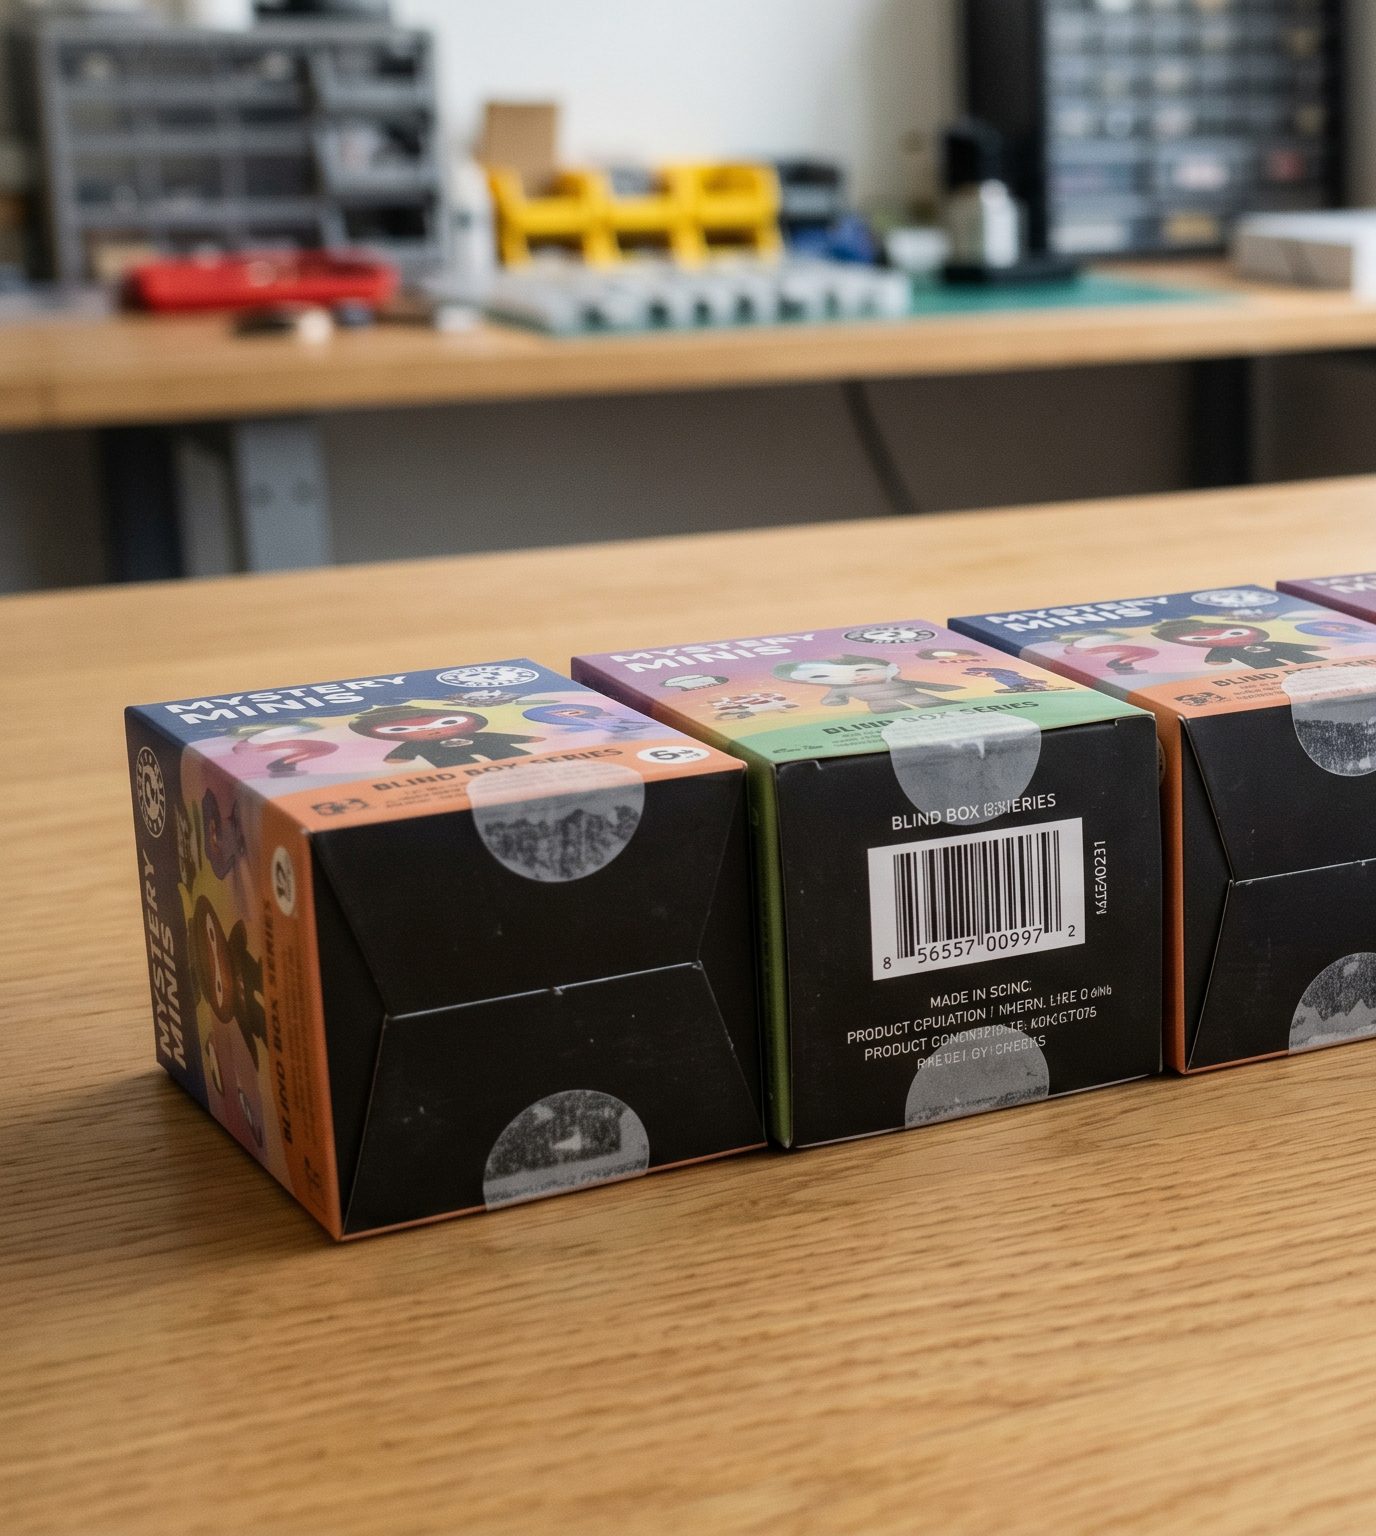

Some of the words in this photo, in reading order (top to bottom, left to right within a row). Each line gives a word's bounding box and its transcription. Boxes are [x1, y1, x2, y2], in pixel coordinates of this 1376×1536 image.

[1003, 606, 1154, 633] MINIS
[609, 633, 819, 663] MYSTERY
[623, 645, 794, 673] MINIS
[1211, 673, 1280, 687] BLIND
[164, 675, 407, 715] MYSTERY
[178, 692, 366, 726] MINIS
[821, 718, 896, 736] BLIND
[958, 700, 1040, 718] SERIES
[372, 770, 457, 792] BLIND
[891, 811, 942, 831] BLIND
[946, 804, 980, 823] BOX
[142, 849, 173, 1060] MYSTERY
[882, 956, 893, 970] 8
[917, 939, 976, 964] 56557
[986, 927, 1043, 952] 00997
[1067, 924, 1076, 938] 2
[160, 921, 187, 1071] MINIS
[930, 991, 970, 1009] MADE
[972, 988, 987, 1001] IN
[847, 1021, 911, 1044] PRODUCT
[864, 1038, 928, 1062] PRODUCT
